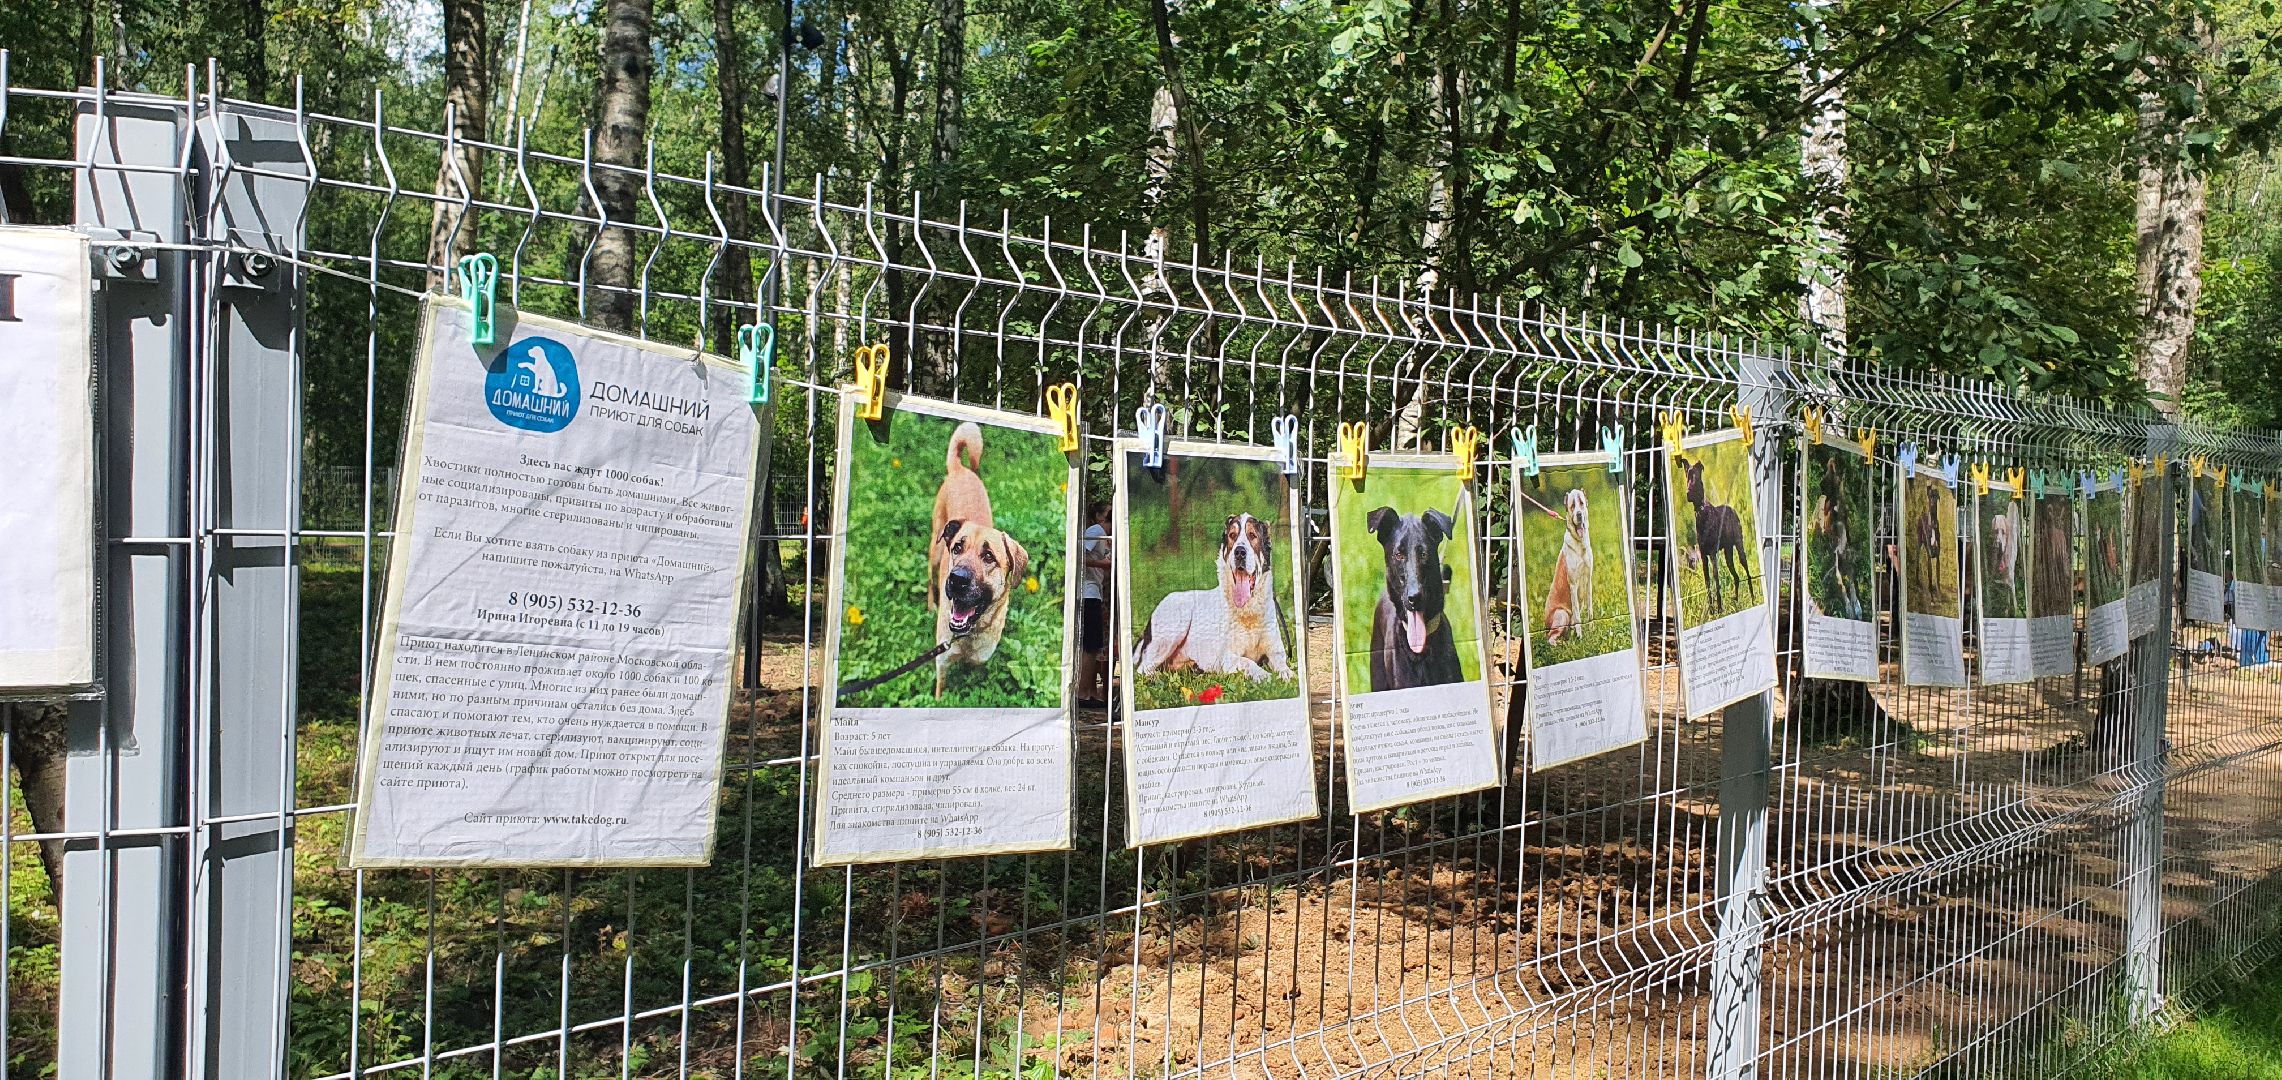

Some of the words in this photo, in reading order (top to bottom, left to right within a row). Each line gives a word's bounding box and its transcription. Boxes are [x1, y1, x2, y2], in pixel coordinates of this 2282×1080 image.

[491, 389, 570, 418] ДОМАШНИЙ
[589, 381, 710, 421] ДОМАШНИЙ
[589, 405, 637, 424] ПРИЮТ
[636, 414, 663, 430] ДЛЯ
[664, 420, 705, 437] СОБАК
[519, 453, 551, 469] Здесь
[553, 462, 572, 473] вас
[574, 465, 602, 479] ждут
[605, 468, 629, 482] 1000
[630, 474, 665, 487] собак!
[423, 455, 482, 475] Хвостики
[484, 467, 546, 484] полностью
[547, 478, 585, 491] готовы
[587, 484, 614, 495] быть
[681, 496, 699, 509] Все
[700, 502, 735, 514] живот-
[421, 474, 445, 486] ные
[447, 479, 553, 503] социализированы,
[555, 495, 602, 510] привиты
[604, 502, 618, 512] по
[619, 505, 665, 522] возрасту
[666, 512, 674, 520] и
[675, 511, 734, 529] обработаны
[418, 493, 433, 501] от
[435, 494, 498, 512] паразитов,
[501, 505, 541, 517] многие
[542, 510, 624, 529] стерилизованы
[625, 522, 633, 530] и
[635, 522, 700, 540] чипированы.
[433, 526, 462, 541] Если
[465, 530, 482, 543] Вы
[484, 535, 523, 548] хотите
[525, 540, 555, 552] взять
[557, 543, 594, 559] собаку
[596, 550, 608, 559] из
[610, 551, 649, 565] приюта
[481, 552, 539, 568] напишите
[540, 559, 607, 576] пожалуйста,
[609, 569, 621, 577] на
[624, 567, 674, 586] WhatsApp
[508, 591, 518, 606] 8
[523, 591, 563, 613] (905)
[567, 597, 642, 618] 532-12-36
[477, 608, 516, 623] Ирина
[518, 612, 573, 628] Игоревна
[575, 617, 586, 630] (с
[588, 619, 599, 630] 11
[601, 623, 615, 633] до
[618, 622, 630, 633] 19
[632, 625, 666, 637] часов)
[399, 635, 441, 651] Приют
[443, 641, 504, 655] находится
[514, 646, 576, 661] Ленинском
[578, 652, 615, 665] районе
[616, 654, 680, 670] Московской
[681, 659, 707, 671] обла-
[396, 656, 421, 667] сти.
[423, 655, 432, 666] В
[435, 658, 457, 668] нем
[460, 660, 522, 673] постоянно
[523, 665, 583, 678] проживает
[585, 670, 616, 680] около
[619, 670, 642, 682] 1000
[643, 673, 672, 684] собак
[673, 675, 681, 684] и
[683, 675, 699, 686] 100
[395, 673, 422, 684] шек,
[425, 674, 487, 688] спасенные
[489, 680, 496, 688] с
[497, 680, 527, 692] улиц.
[529, 679, 573, 693] Многие
[574, 685, 587, 694] из
[588, 686, 610, 696] них
[611, 688, 640, 701] ранее
[641, 687, 669, 700] были
[392, 690, 428, 702] ними,
[430, 692, 446, 702] но
[449, 694, 464, 703] по
[466, 695, 510, 706] разным
[513, 698, 568, 710] причинам
[570, 702, 617, 712] остались
[619, 703, 636, 713] без
[637, 706, 666, 715] дома.
[667, 705, 695, 717] Здесь
[390, 707, 440, 719] спасают
[442, 711, 450, 719] и
[452, 711, 510, 723] помогают
[511, 714, 534, 725] тем,
[536, 716, 556, 725] кто
[557, 716, 589, 727] очень
[591, 719, 645, 731] нуждается
[656, 722, 698, 732] помощи.
[701, 722, 708, 732] В
[834, 717, 859, 727] Майя
[387, 725, 433, 738] приюте
[435, 727, 497, 739] животных
[534, 732, 604, 745] стерилизуют,
[871, 731, 876, 740] 5
[384, 742, 450, 758] ализируют
[452, 746, 461, 754] и
[463, 746, 495, 758] ищут
[498, 748, 514, 756] им
[516, 747, 551, 758] новый
[580, 748, 617, 763] Приют
[618, 752, 657, 765] открыт
[657, 755, 675, 764] для
[677, 755, 703, 764] посе-
[380, 777, 414, 788] сайте
[416, 777, 469, 791] приюта).
[382, 759, 424, 772] щений
[426, 761, 473, 772] каждый
[476, 764, 503, 773] день
[505, 762, 548, 777] (график
[551, 766, 591, 778] работы
[593, 768, 629, 777] можно
[631, 770, 689, 782] посмотреть
[691, 771, 703, 780] на
[464, 812, 494, 824] Сайт
[495, 814, 540, 826] приюта:
[917, 830, 922, 839] 8
[944, 826, 983, 837] 532-12-36
